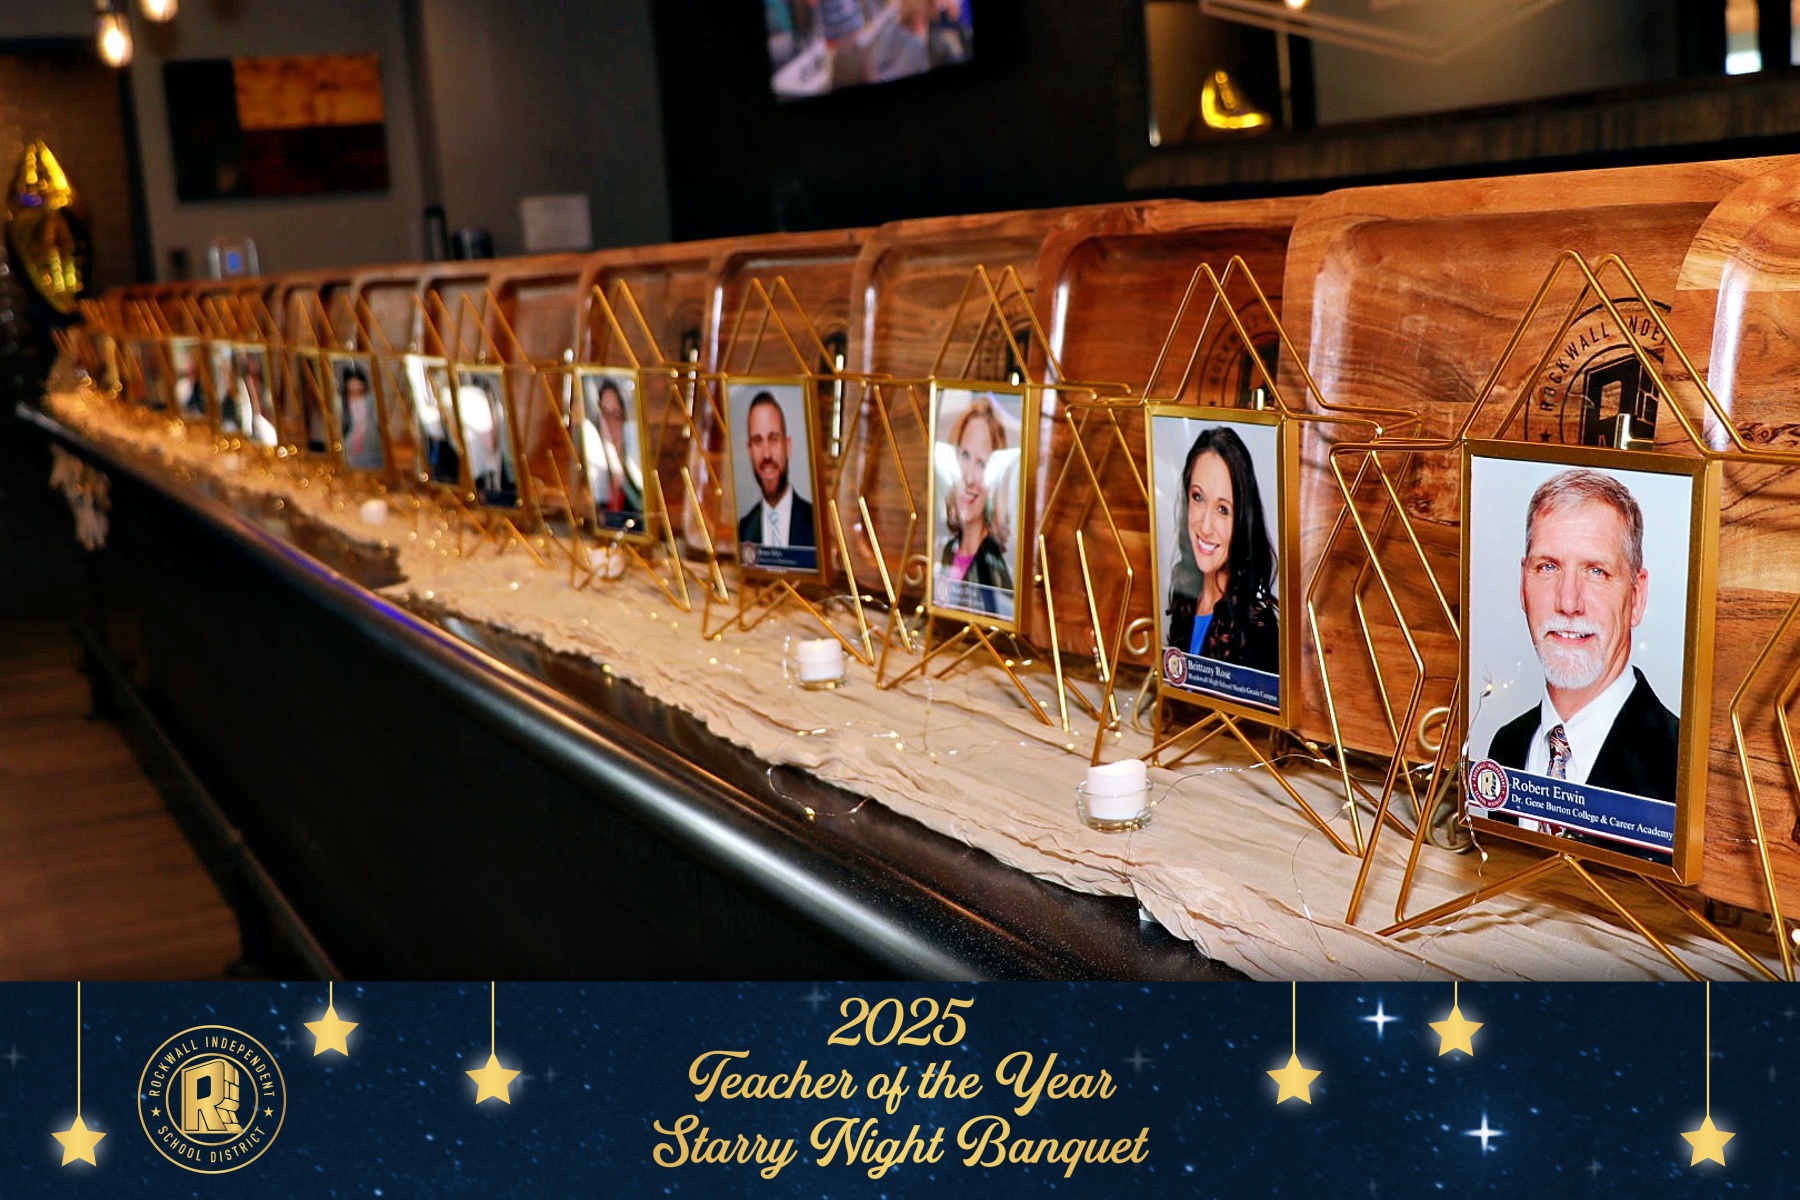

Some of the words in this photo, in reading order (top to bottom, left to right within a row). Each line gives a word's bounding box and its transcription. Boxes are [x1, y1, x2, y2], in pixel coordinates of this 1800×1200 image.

[1540, 322, 1610, 412] ROCKWALL
[1187, 660, 1214, 677] Brittany
[1215, 666, 1231, 680] Rose
[1511, 776, 1550, 797] Robert
[1553, 786, 1586, 806] Erwin
[1511, 793, 1524, 805] Dr.
[1524, 797, 1545, 809] Gene
[1546, 801, 1571, 816] Burton
[1572, 808, 1600, 824] College
[1600, 815, 1608, 825] &
[1609, 816, 1635, 831] Career
[1636, 823, 1674, 841] Academy
